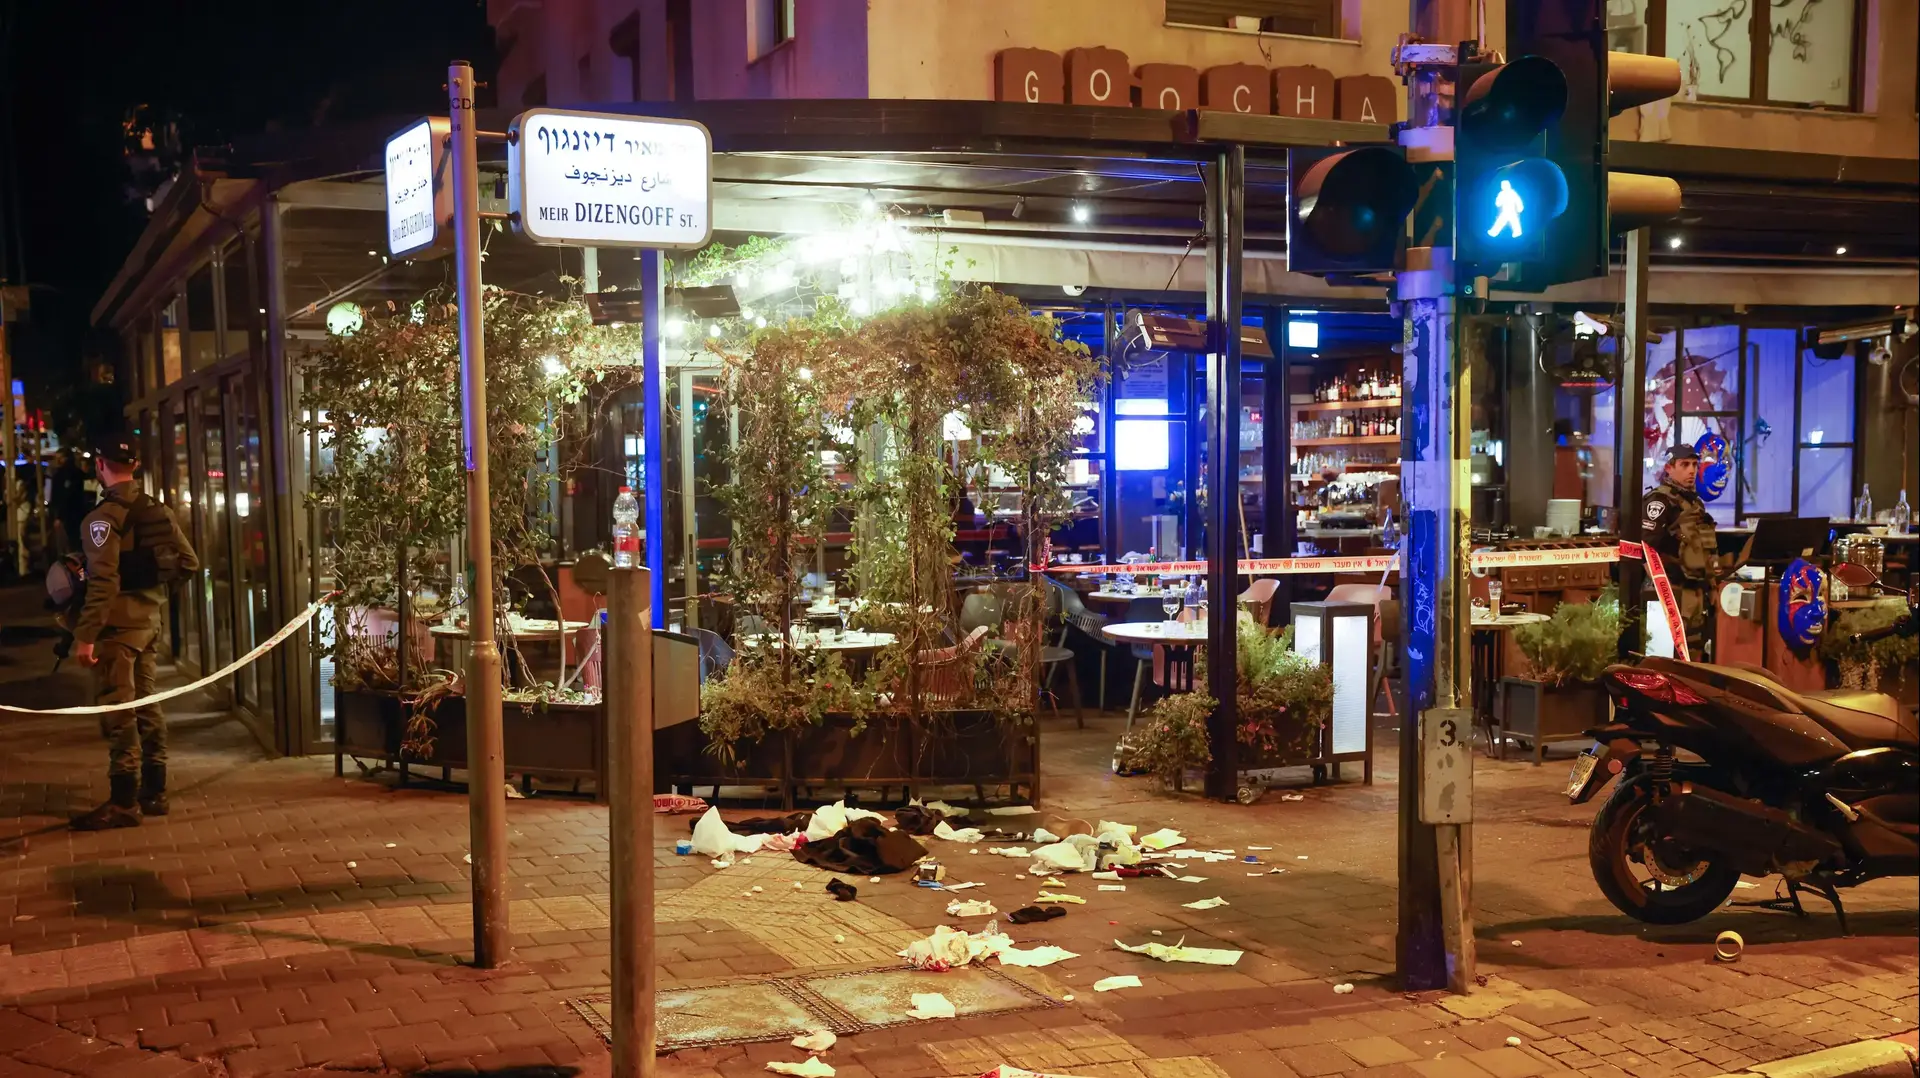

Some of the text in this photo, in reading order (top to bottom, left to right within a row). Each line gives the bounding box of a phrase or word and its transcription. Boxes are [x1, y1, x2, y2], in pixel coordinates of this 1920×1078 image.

[1024, 68, 1377, 123] GOOCHA
[538, 125, 615, 156] דיזנגוף
[539, 202, 698, 228] MEIR DIZENGOFF ST.
[1571, 552, 1580, 561] אין
[1591, 550, 1611, 559] ישראל
[1332, 559, 1351, 569] מעבר
[1485, 555, 1506, 564] ישראל
[1258, 561, 1281, 570] ישראל
[1294, 561, 1321, 570] משטרת
[1353, 560, 1363, 569] אין
[1440, 719, 1457, 747] 3
